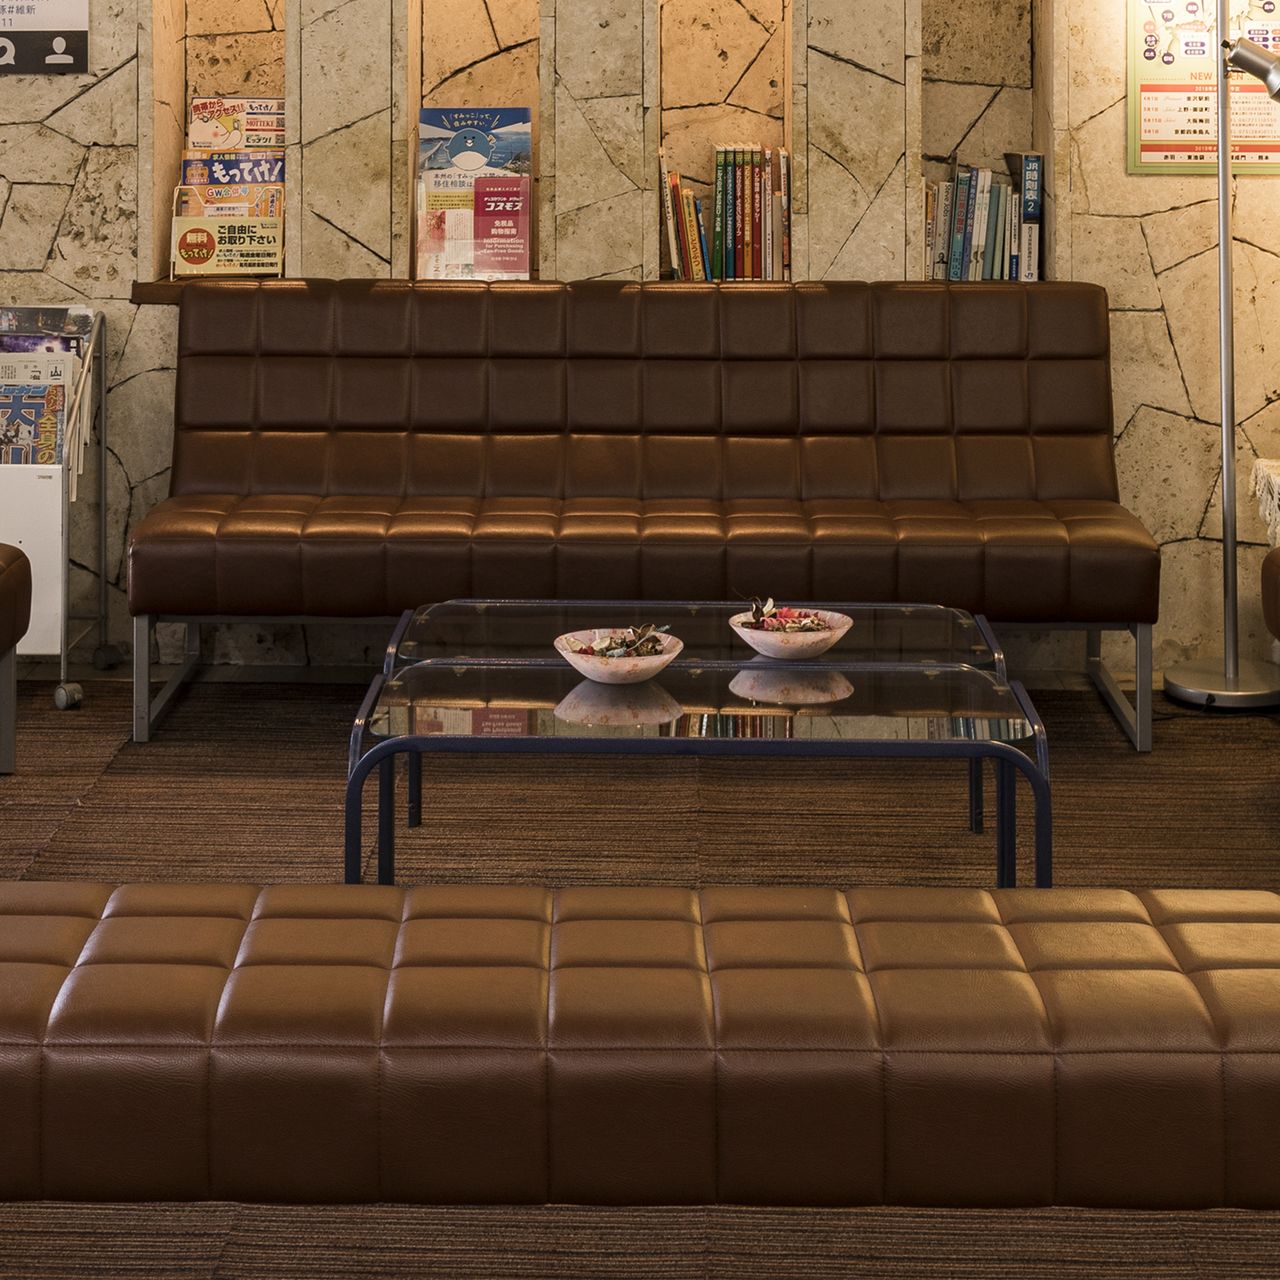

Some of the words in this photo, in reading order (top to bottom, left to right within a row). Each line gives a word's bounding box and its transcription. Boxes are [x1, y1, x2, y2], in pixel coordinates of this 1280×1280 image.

[1190, 72, 1213, 81] NEW
[485, 202, 523, 211] コスモス
[217, 225, 257, 235] ご自由に
[186, 232, 208, 243] 無料
[217, 235, 276, 246] お取り下さい
